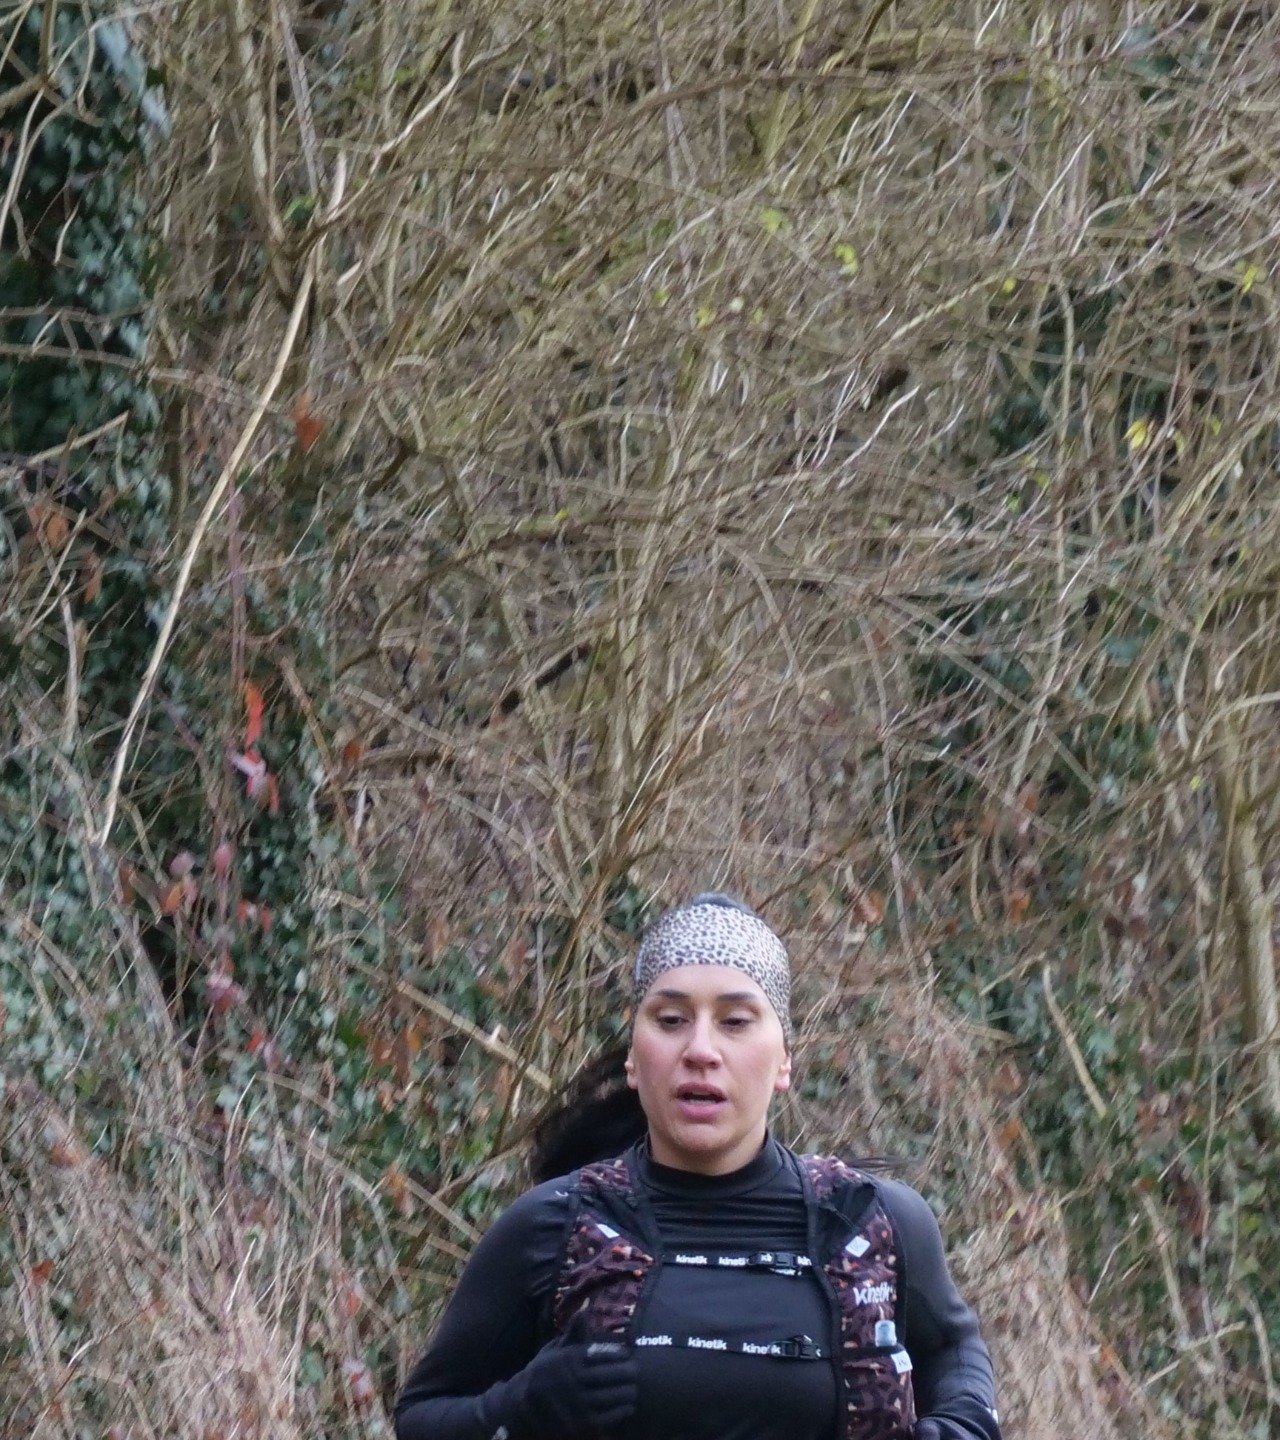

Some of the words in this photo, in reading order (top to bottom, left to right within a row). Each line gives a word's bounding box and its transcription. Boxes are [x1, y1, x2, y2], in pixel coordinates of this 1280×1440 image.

[675, 1254, 708, 1265] kinetik
[718, 1256, 749, 1266] kineti
[688, 1336, 727, 1350] kinetik
